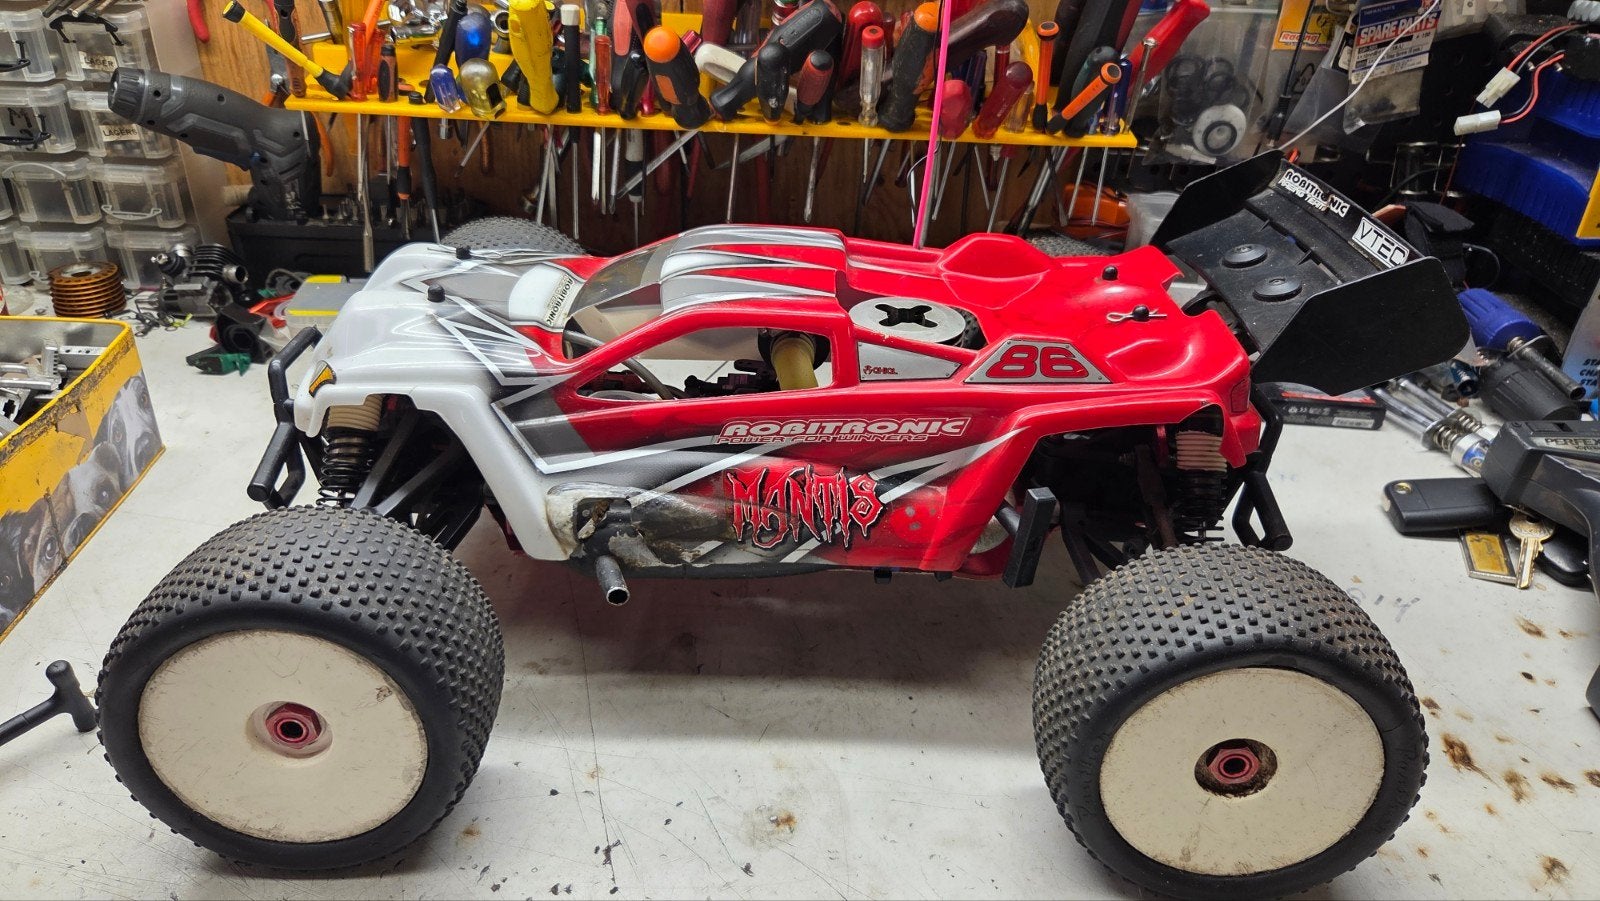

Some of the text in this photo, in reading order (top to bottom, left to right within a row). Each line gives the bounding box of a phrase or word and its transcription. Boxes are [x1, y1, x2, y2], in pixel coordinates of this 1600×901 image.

[1281, 33, 1319, 42] Racng
[1360, 12, 1438, 42] SPARE PARTS
[84, 57, 114, 67] LAGER
[102, 128, 138, 138] LAGERS
[1360, 221, 1406, 266] VTEC
[546, 278, 573, 325] ROBITRONIC
[986, 344, 1090, 378] 86
[716, 432, 929, 444] POWER FOR WINNERS
[722, 418, 968, 437] ROBITRONIC
[727, 464, 883, 549] MANTIS
